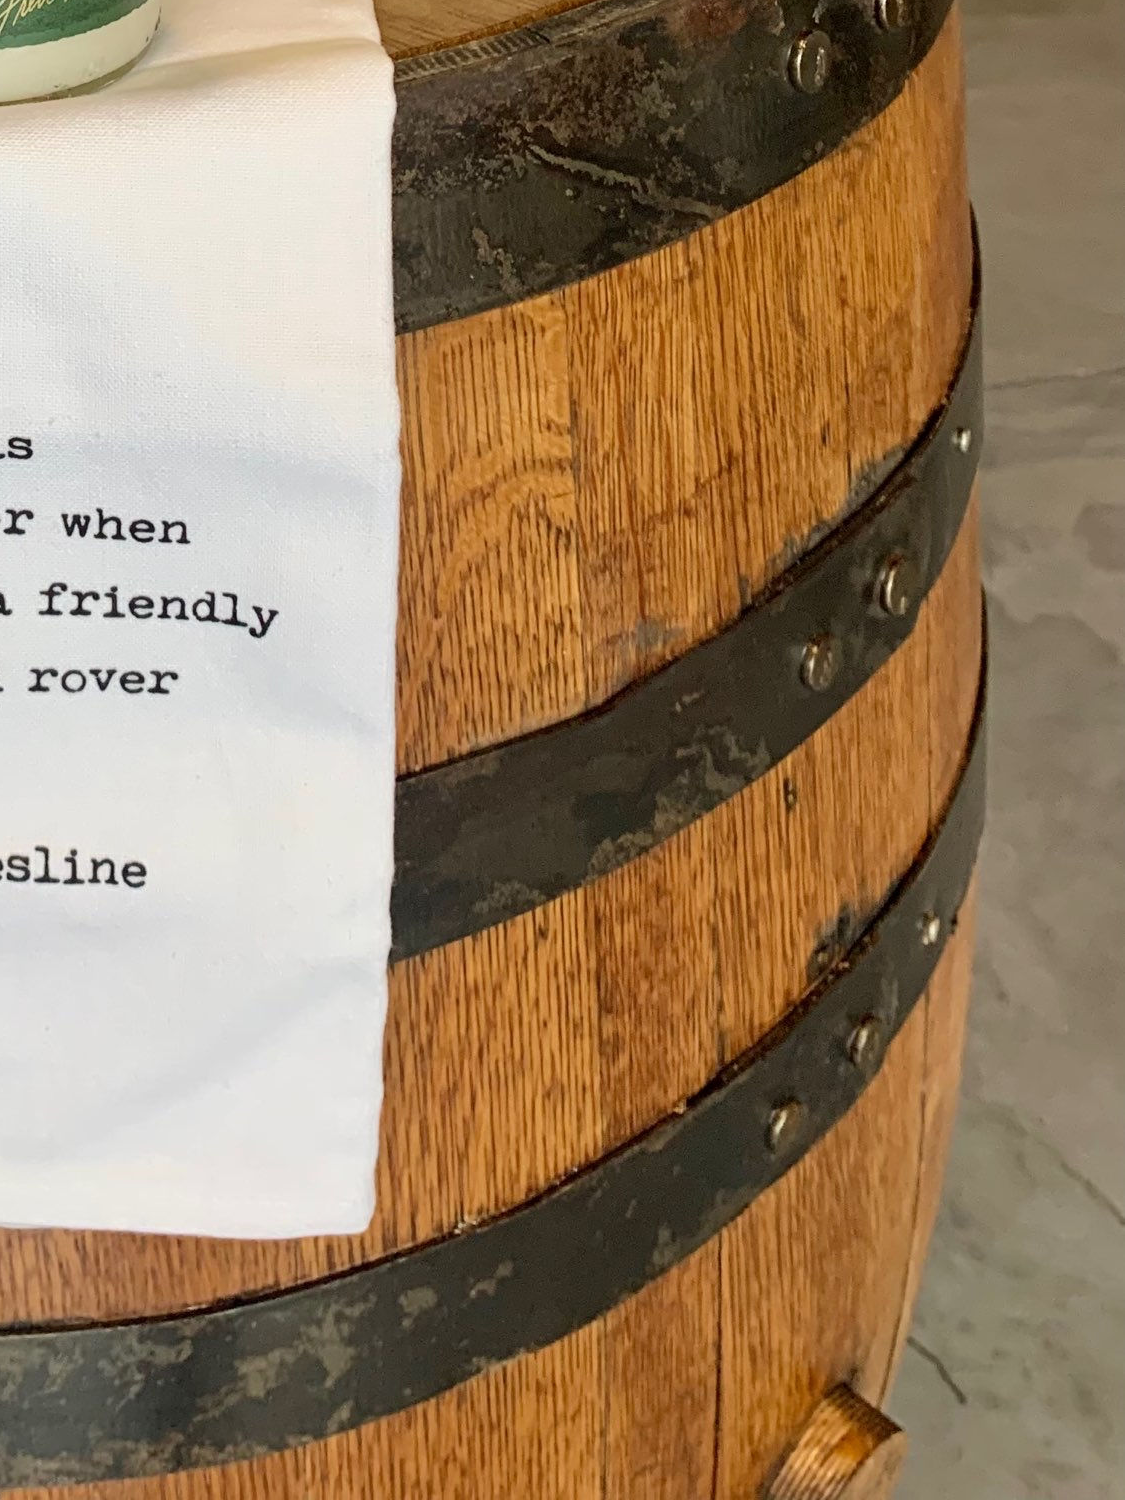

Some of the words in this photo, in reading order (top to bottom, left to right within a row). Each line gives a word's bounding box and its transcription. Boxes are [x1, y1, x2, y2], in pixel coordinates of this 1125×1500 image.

[60, 507, 192, 545] when
[37, 581, 280, 640] friendly
[27, 667, 180, 696] rover
